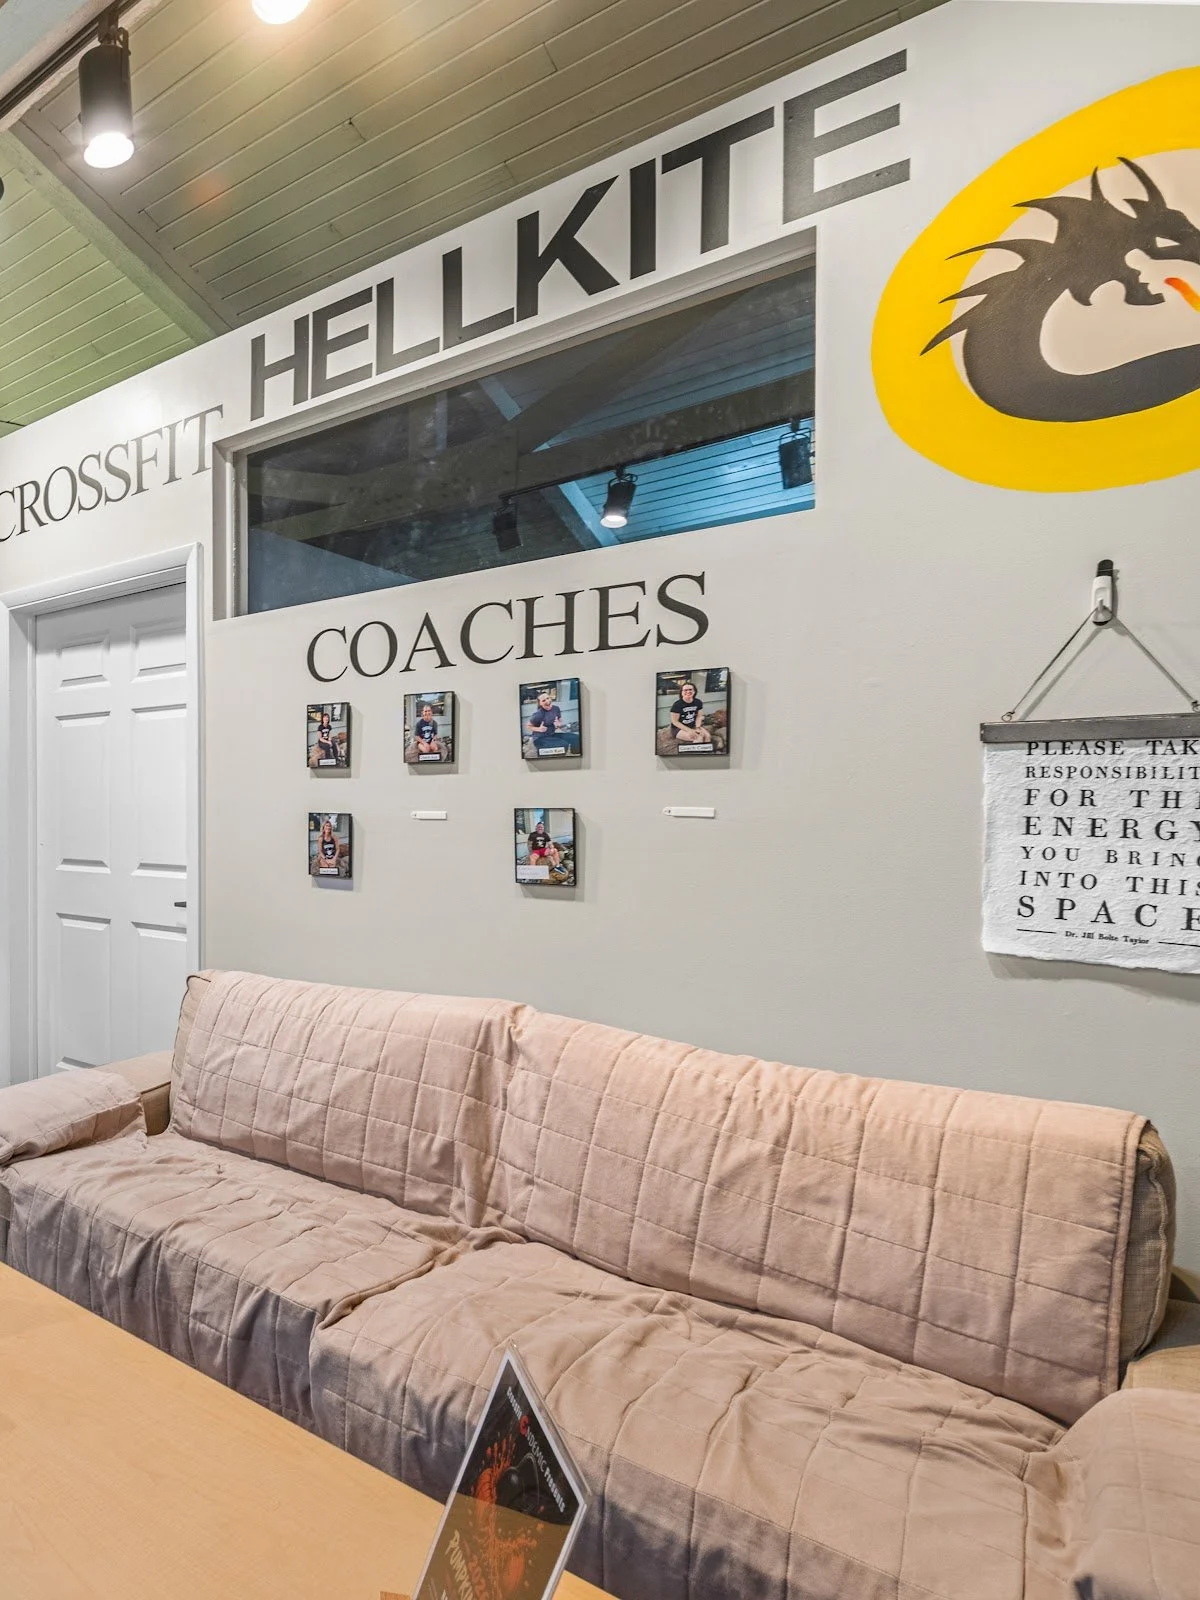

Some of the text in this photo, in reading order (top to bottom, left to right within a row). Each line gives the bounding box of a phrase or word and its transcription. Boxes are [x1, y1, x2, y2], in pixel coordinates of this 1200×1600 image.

[250, 49, 910, 420] HELLKITE
[306, 571, 711, 682] COACHES
[1026, 740, 1125, 755] PLEASE
[1025, 789, 1200, 810] FOR TH
[1021, 846, 1200, 867] YOU BRIN
[1020, 870, 1097, 890] INTO
[1017, 896, 1200, 931] SPACE
[1122, 935, 1149, 945] Taylor
